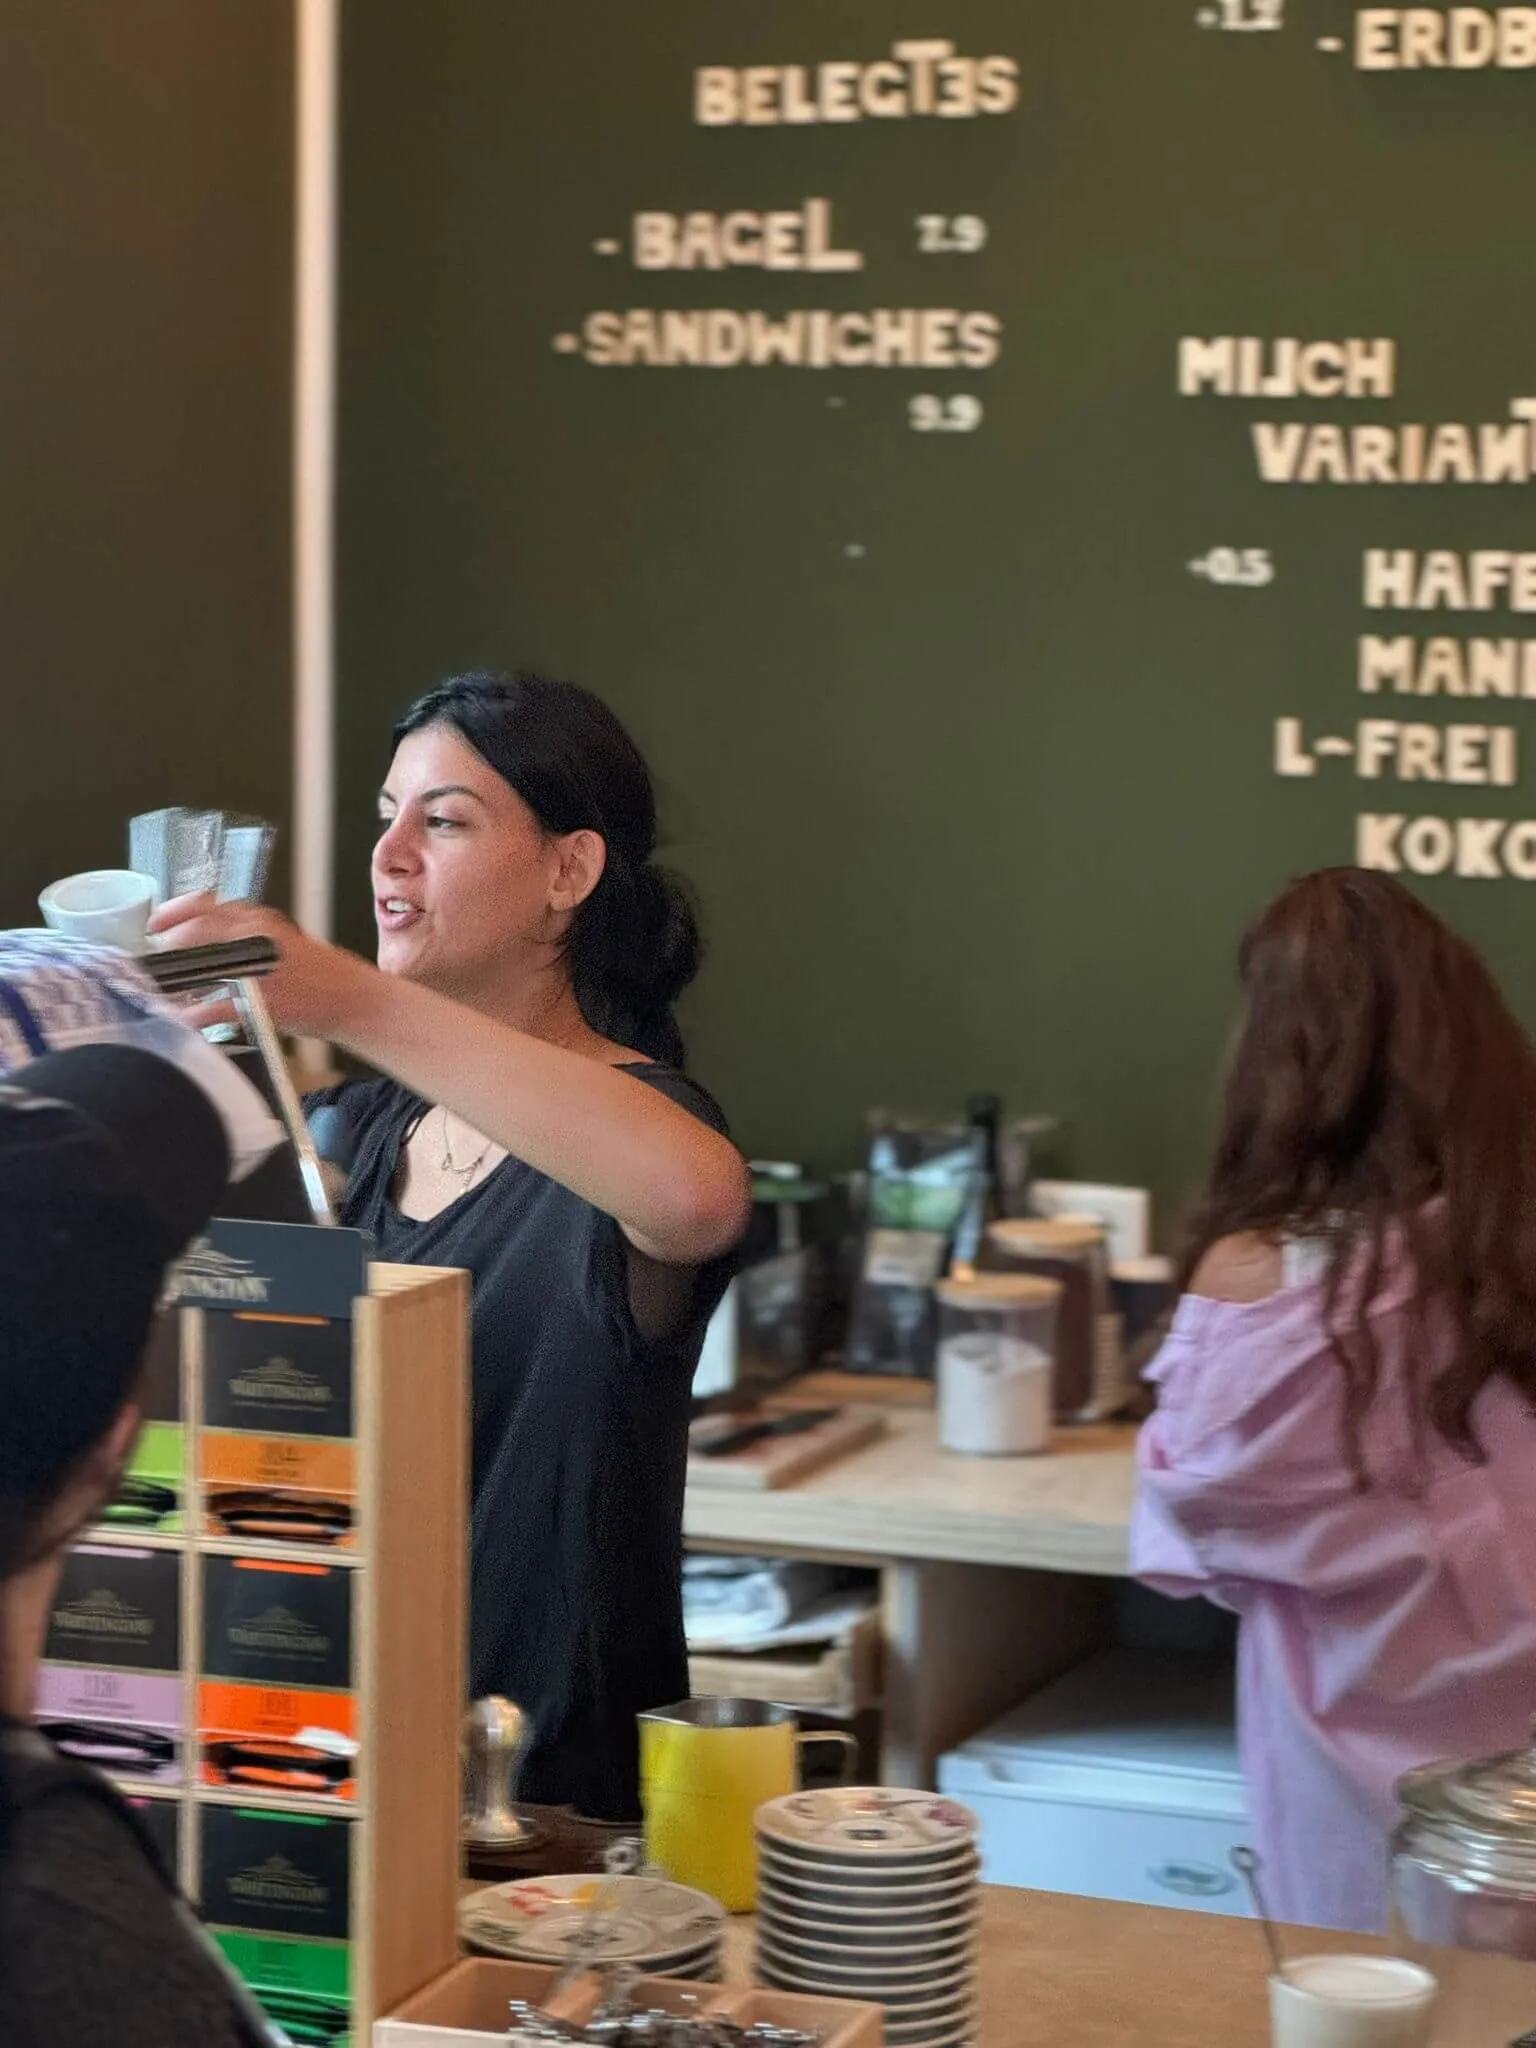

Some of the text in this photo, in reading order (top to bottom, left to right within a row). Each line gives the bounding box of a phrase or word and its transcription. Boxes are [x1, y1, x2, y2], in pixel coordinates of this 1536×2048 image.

[696, 40, 1018, 125] BELEGTES
[635, 199, 861, 271] BAGEL
[1179, 336, 1394, 397] MILCH
[1275, 717, 1515, 786] L-FREI
